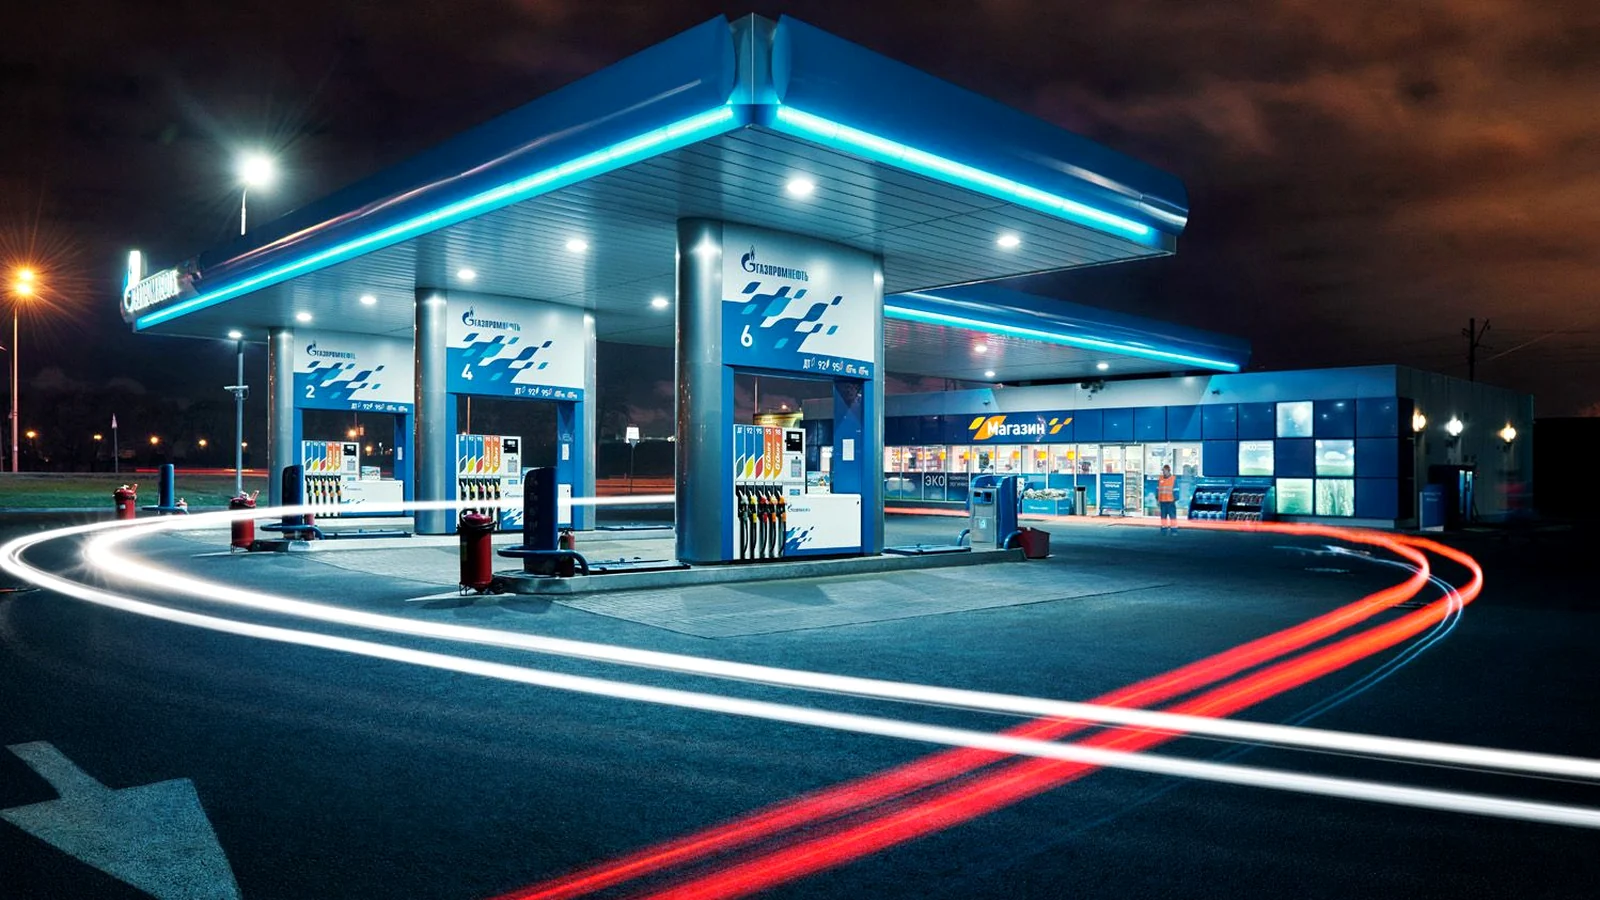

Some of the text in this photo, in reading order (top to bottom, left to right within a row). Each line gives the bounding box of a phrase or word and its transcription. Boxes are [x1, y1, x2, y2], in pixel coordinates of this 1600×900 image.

[756, 263, 809, 282] ГАЗПРОМНЕФТЬ
[740, 325, 753, 347] 6
[461, 363, 473, 380] 4
[817, 360, 827, 371] 92
[305, 385, 315, 398] 2
[746, 427, 753, 435] 92
[987, 420, 1046, 436] Магазин
[925, 475, 945, 487] ЭКО
